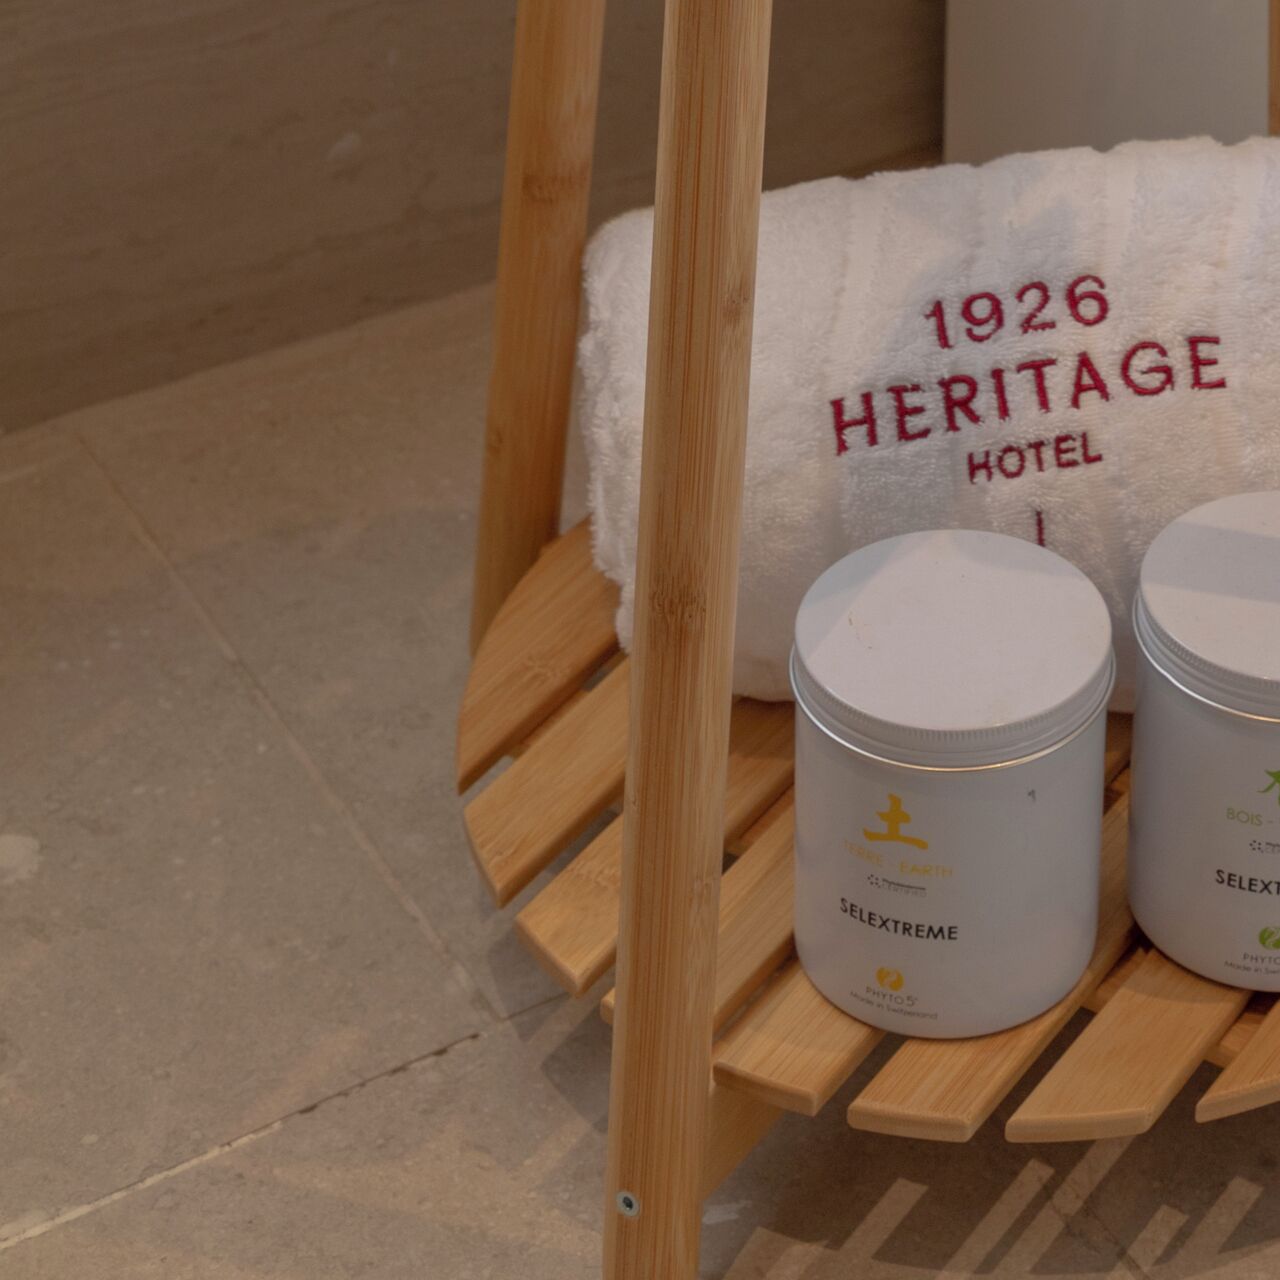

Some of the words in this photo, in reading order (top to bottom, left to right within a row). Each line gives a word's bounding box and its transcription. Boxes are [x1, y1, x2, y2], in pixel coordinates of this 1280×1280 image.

[924, 274, 1110, 349] 1926
[830, 336, 1226, 457] HERITAGE
[967, 431, 1104, 485] HOTEL
[863, 793, 929, 850] 土
[1226, 807, 1263, 826] BOIS
[899, 860, 954, 878] EARTH
[840, 897, 958, 941] SELEXTREME
[1224, 960, 1251, 972] Made
[866, 986, 905, 1005] PHYTO
